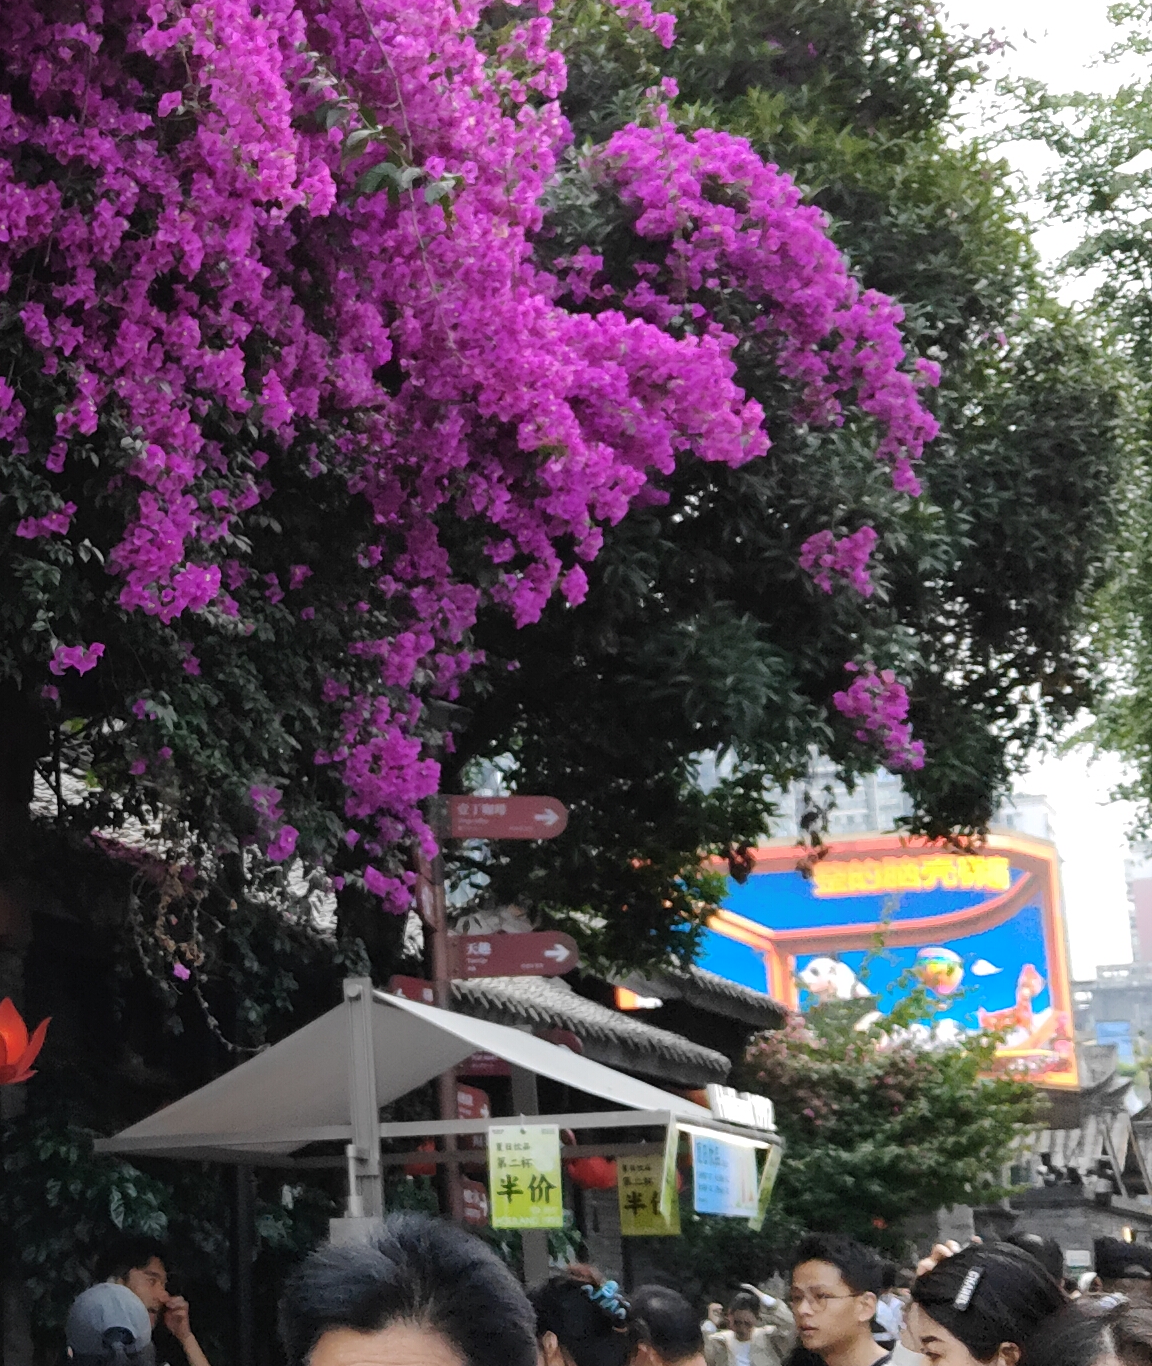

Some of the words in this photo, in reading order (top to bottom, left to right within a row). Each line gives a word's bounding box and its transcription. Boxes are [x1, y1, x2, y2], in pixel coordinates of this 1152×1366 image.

[497, 1156, 533, 1169] 第二杯
[496, 1173, 557, 1204] 半价
